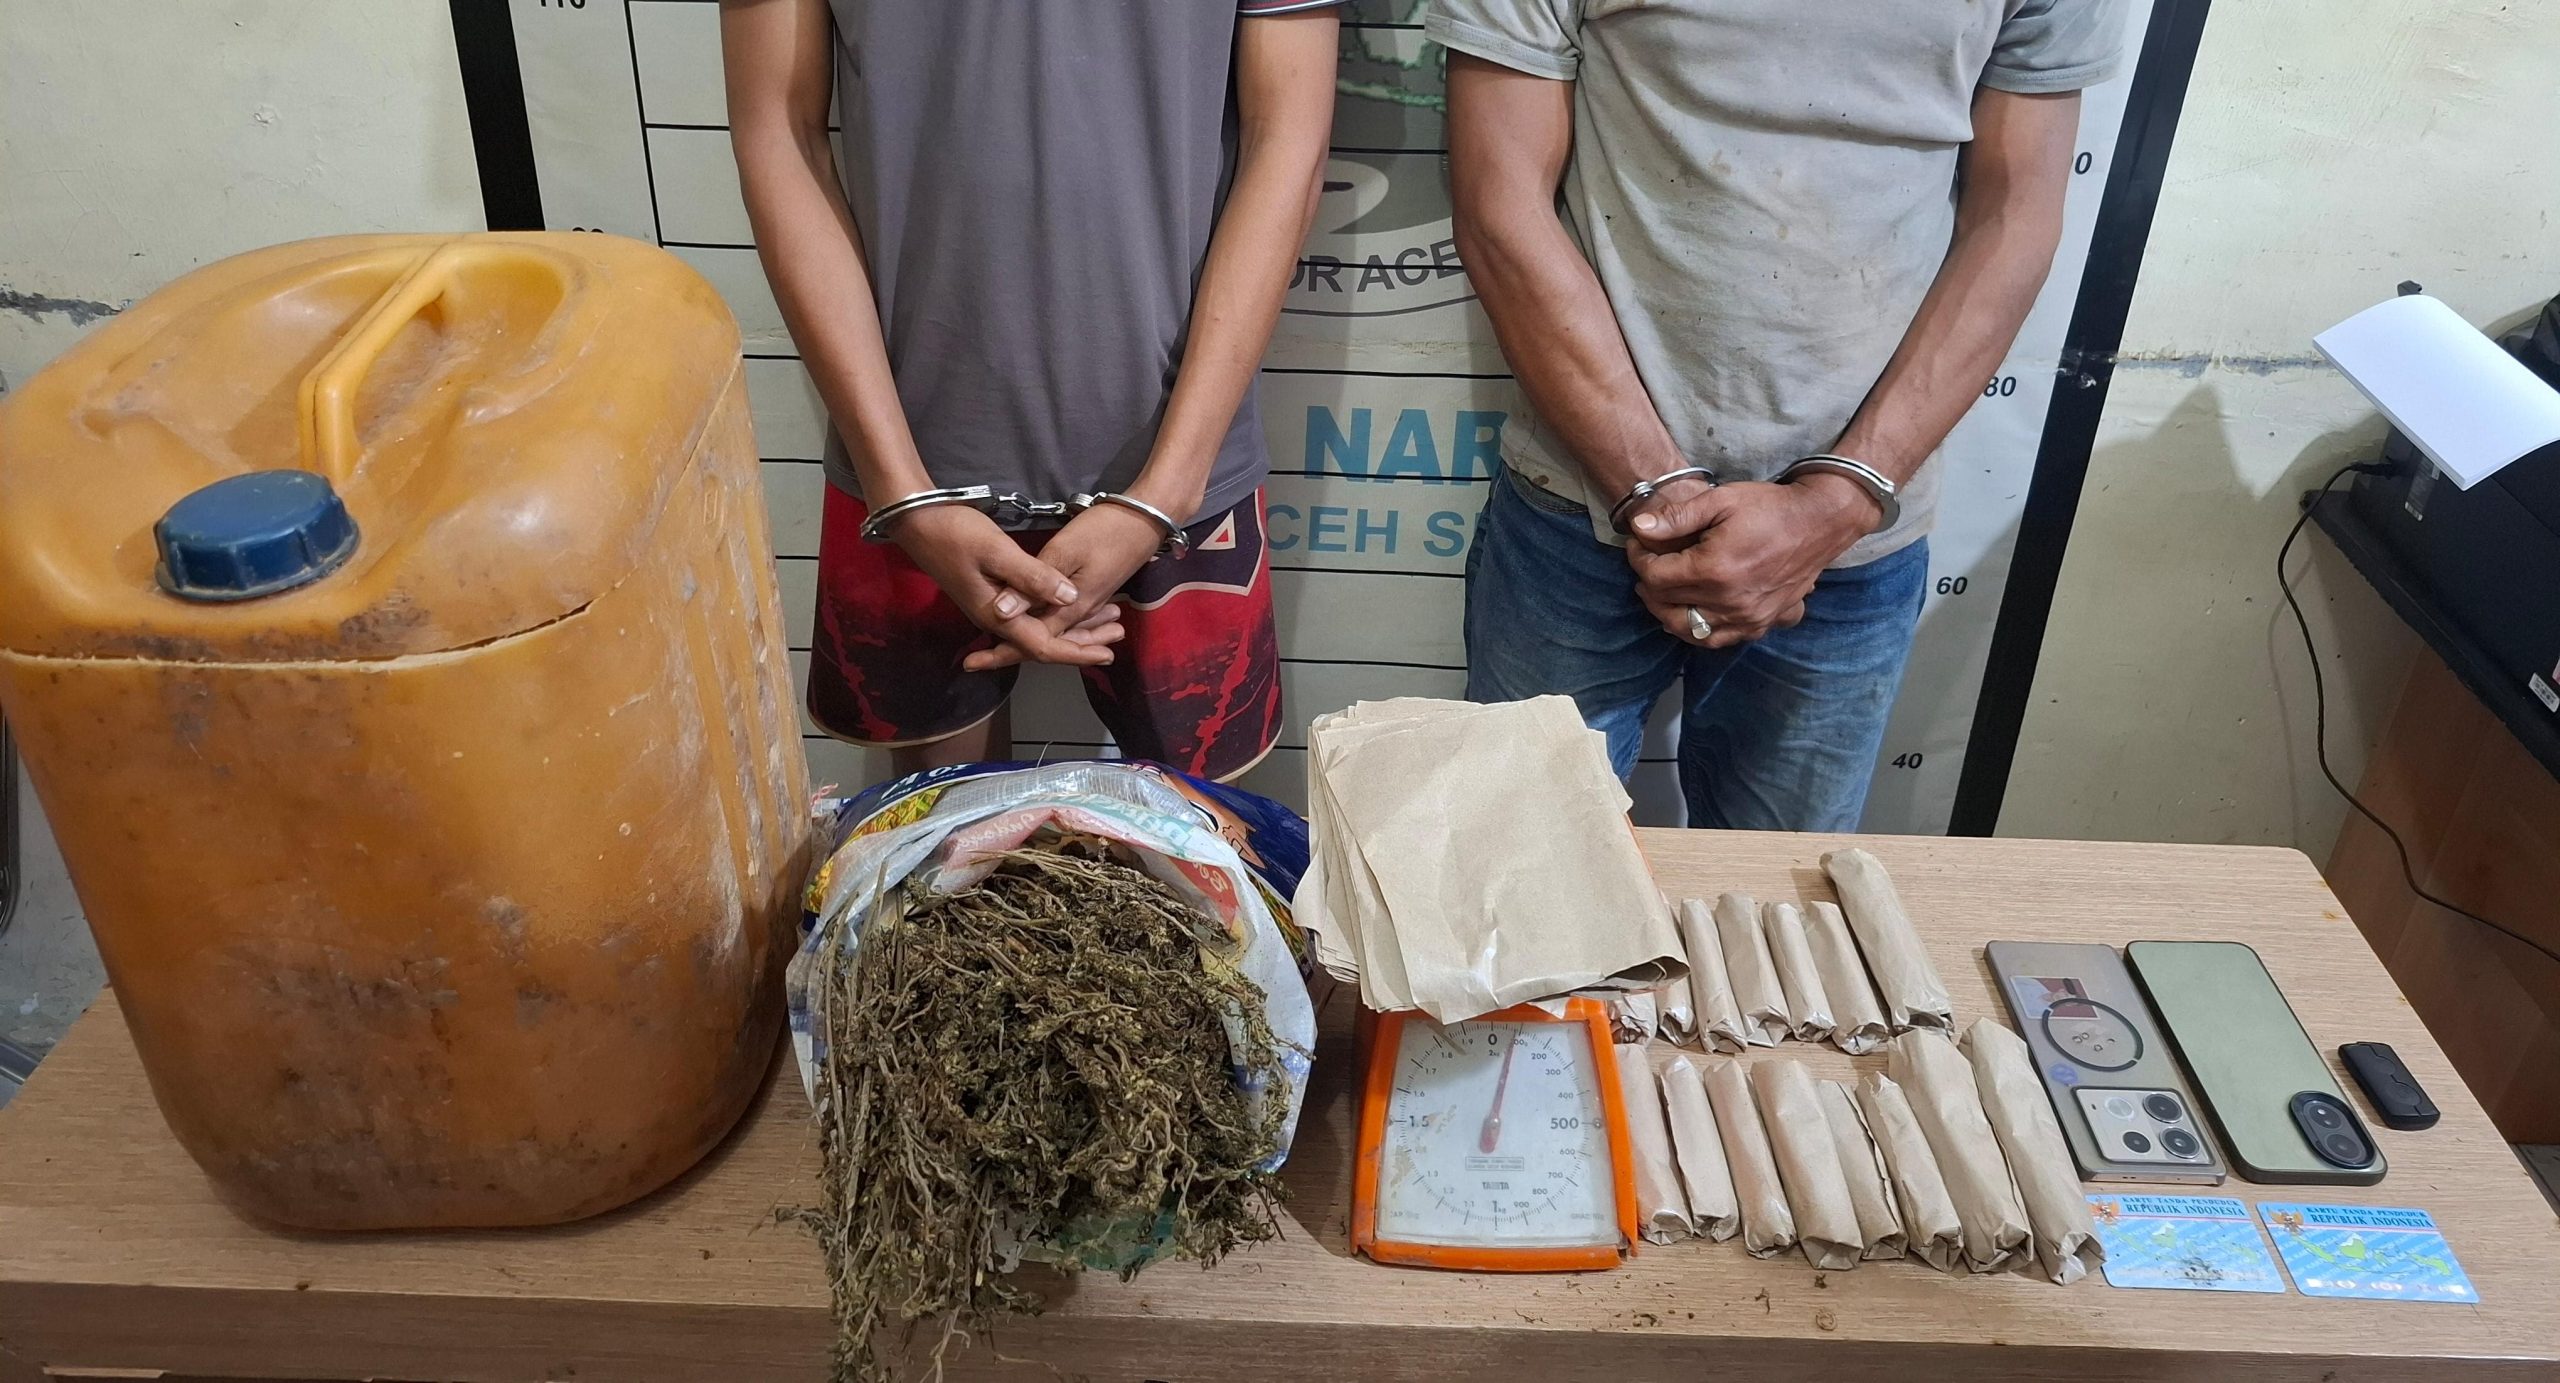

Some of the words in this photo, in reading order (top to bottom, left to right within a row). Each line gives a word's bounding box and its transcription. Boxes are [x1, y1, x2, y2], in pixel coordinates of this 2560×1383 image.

[1983, 376, 2017, 397] 80
[1304, 405, 1508, 485] NAR
[1266, 504, 1399, 554] CEH
[1423, 510, 1482, 557] S
[1936, 576, 1968, 595] 60
[1891, 752, 1923, 769] 40
[1487, 1033, 1498, 1046] 0
[1550, 1117, 1579, 1130] 500
[1548, 1171, 1564, 1179] 700
[2121, 1196, 2151, 1204] KARTU
[2156, 1197, 2188, 1205] TANDA
[2191, 1198, 2241, 1207] PENDUDUK
[2126, 1203, 2181, 1214] REPUBLIK
[2186, 1205, 2246, 1217] INDONESIA
[2305, 1206, 2339, 1214] KARTU
[2343, 1208, 2372, 1216] TANDA
[2377, 1209, 2428, 1218] PENDUDUK
[2310, 1213, 2368, 1226] REPUBLIK
[2372, 1216, 2434, 1229] INDONESIA
